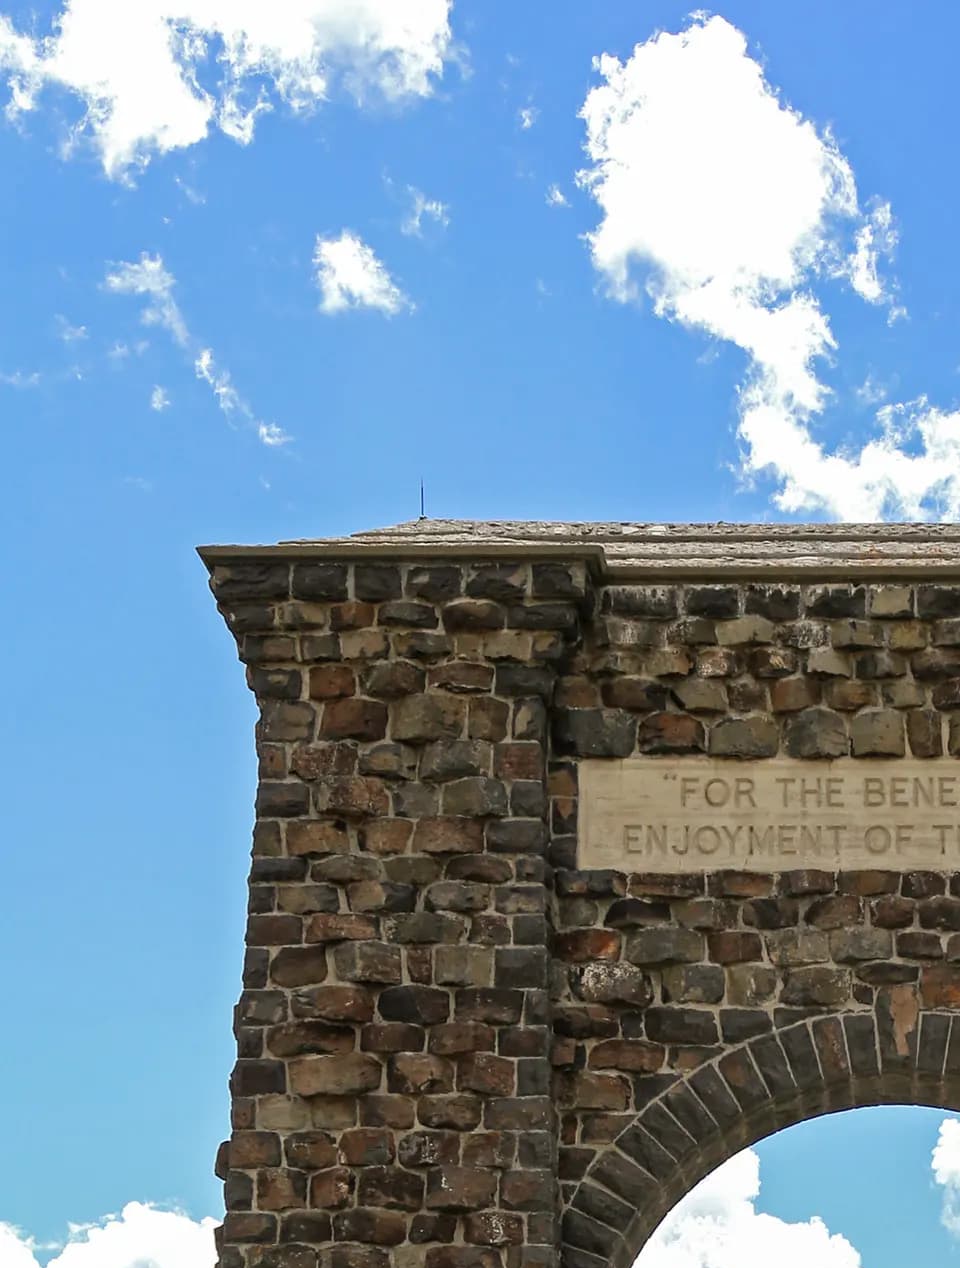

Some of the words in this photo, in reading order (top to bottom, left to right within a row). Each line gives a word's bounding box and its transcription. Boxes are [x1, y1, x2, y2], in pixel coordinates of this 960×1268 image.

[663, 773, 757, 807] “FOR
[775, 776, 845, 807] THE
[623, 824, 847, 855] ENJOYMENT
[864, 824, 914, 855] OF
